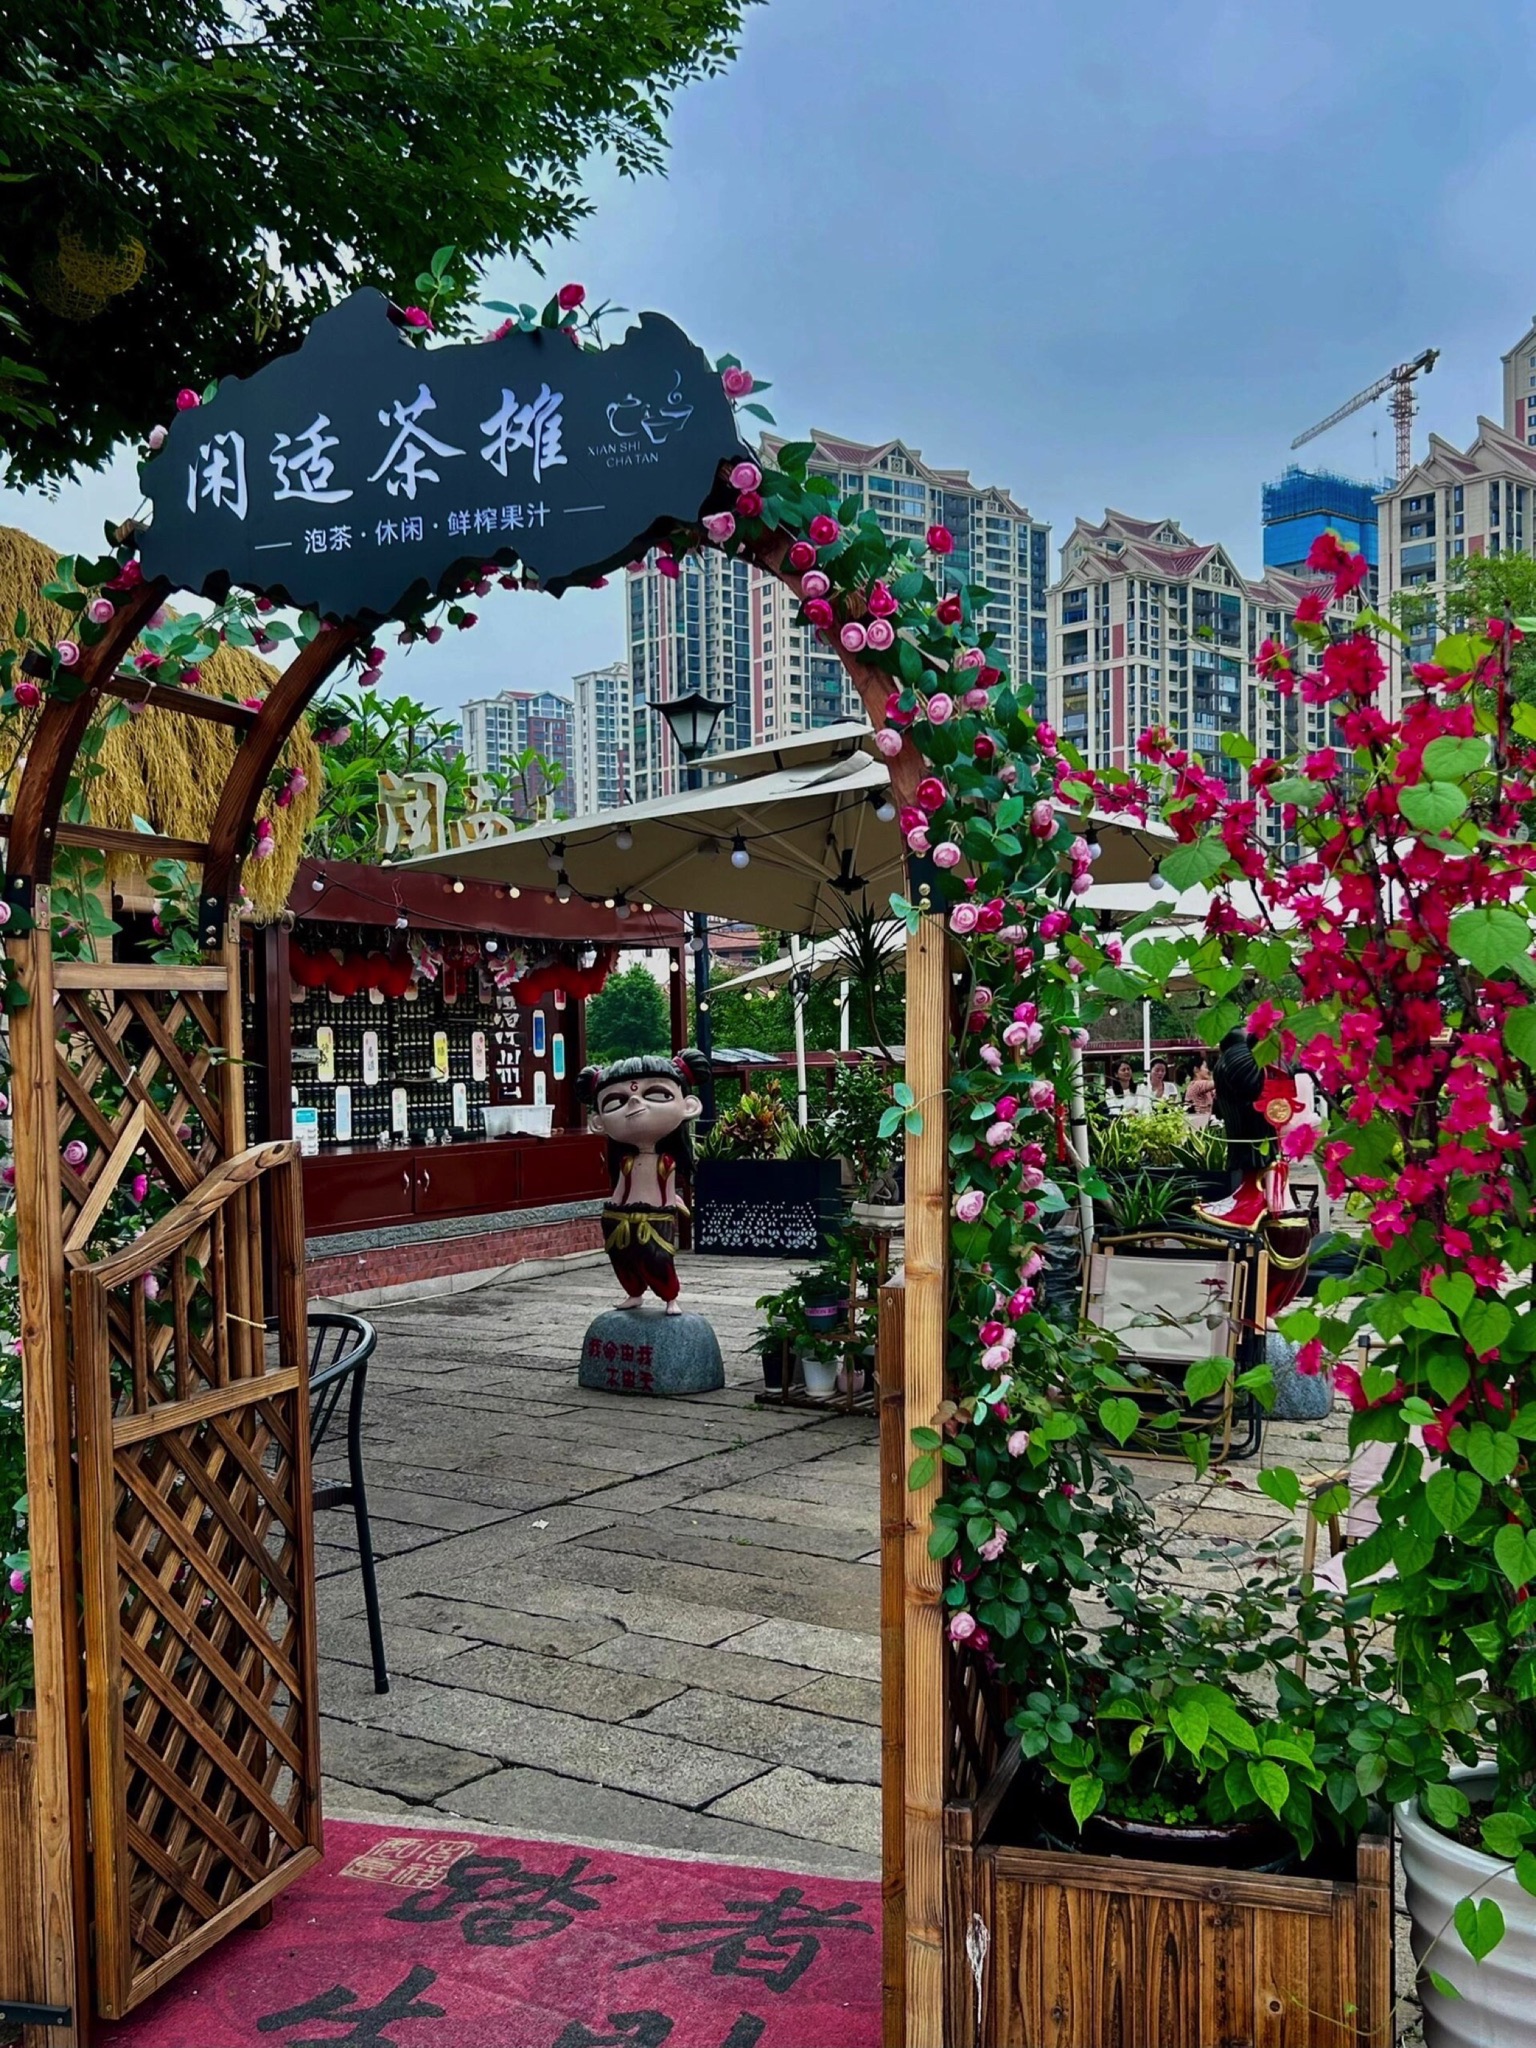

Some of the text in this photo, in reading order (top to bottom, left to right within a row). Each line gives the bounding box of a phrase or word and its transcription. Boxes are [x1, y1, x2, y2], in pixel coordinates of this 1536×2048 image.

[186, 382, 569, 520] 闲适茶摊
[587, 440, 641, 456] XIAN SHI
